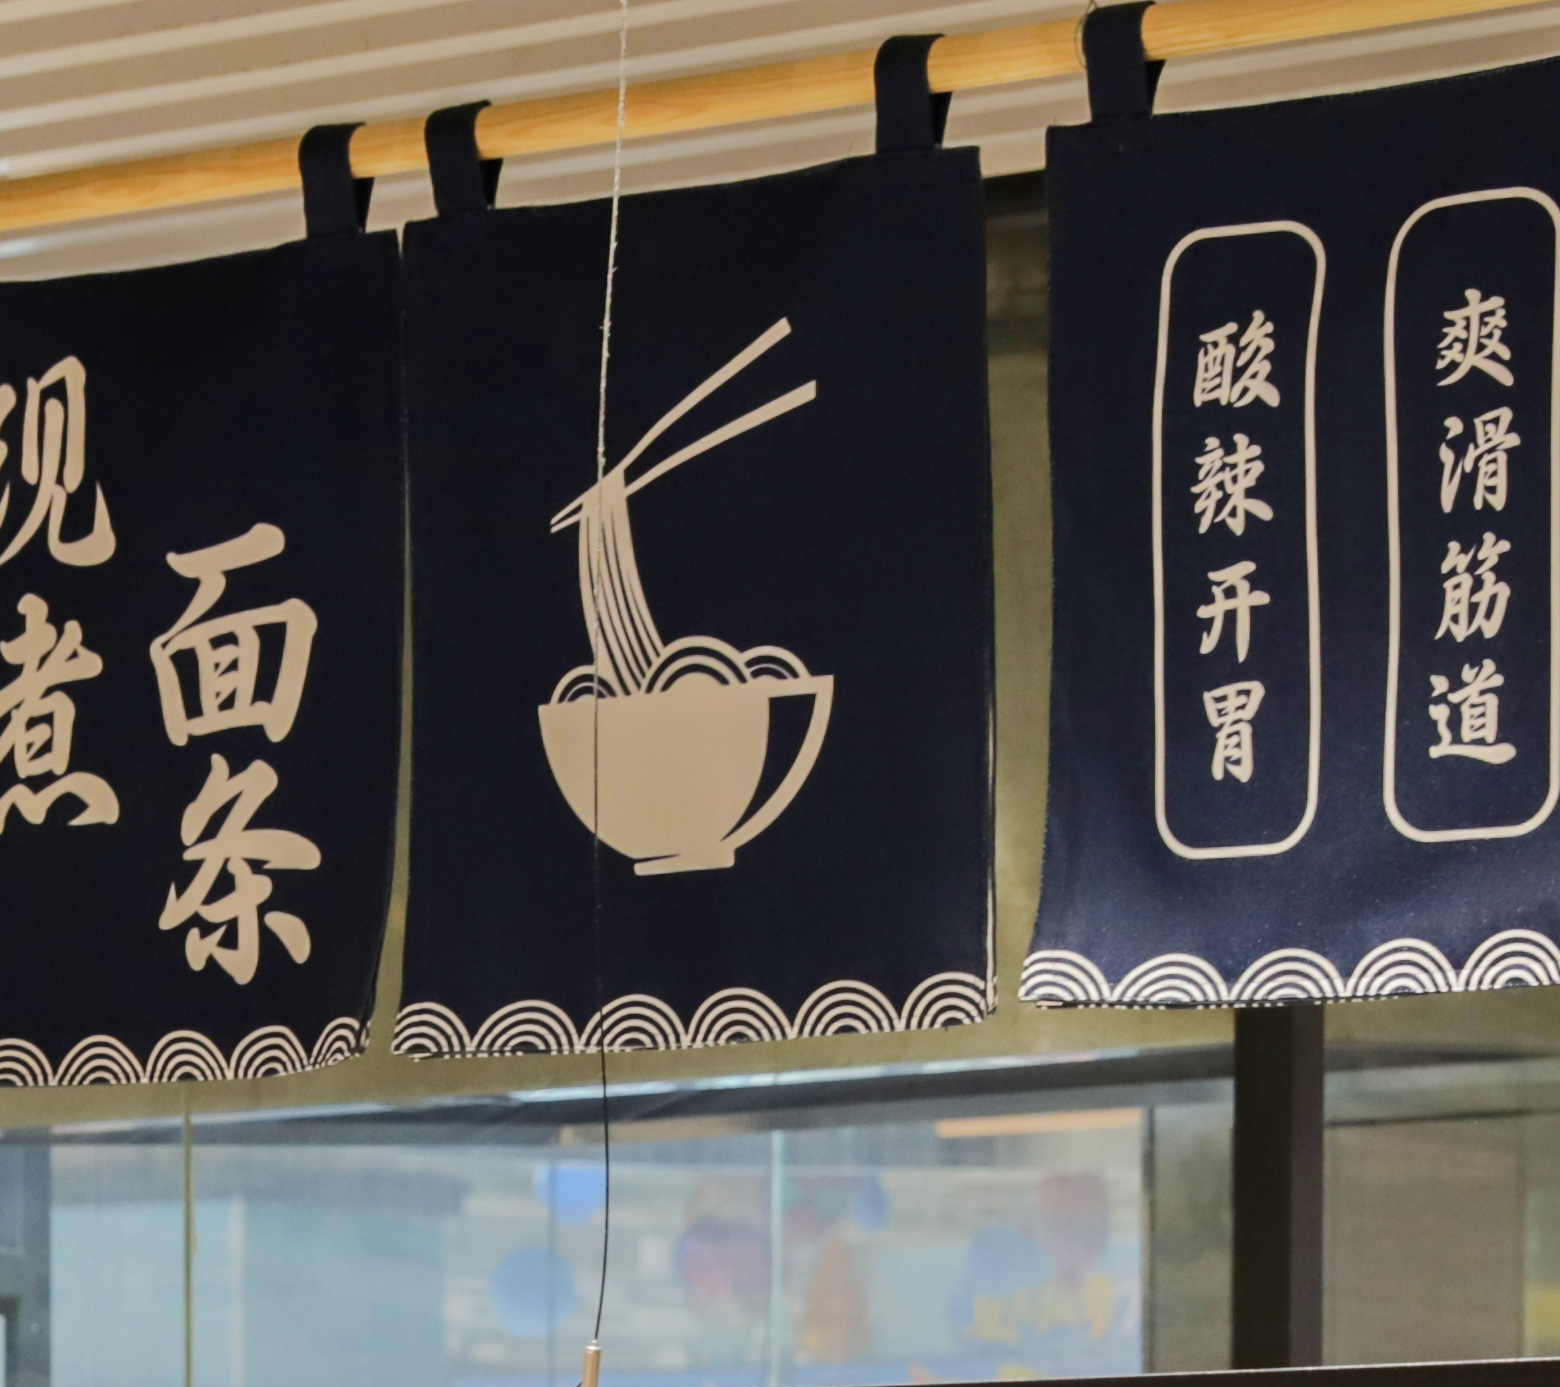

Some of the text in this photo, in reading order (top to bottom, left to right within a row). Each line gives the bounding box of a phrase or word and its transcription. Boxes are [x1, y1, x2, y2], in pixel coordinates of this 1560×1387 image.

[149, 521, 321, 984] 面条
[1189, 309, 1281, 785] 酸辣开胃
[1429, 289, 1520, 765] 爽滑筋道
